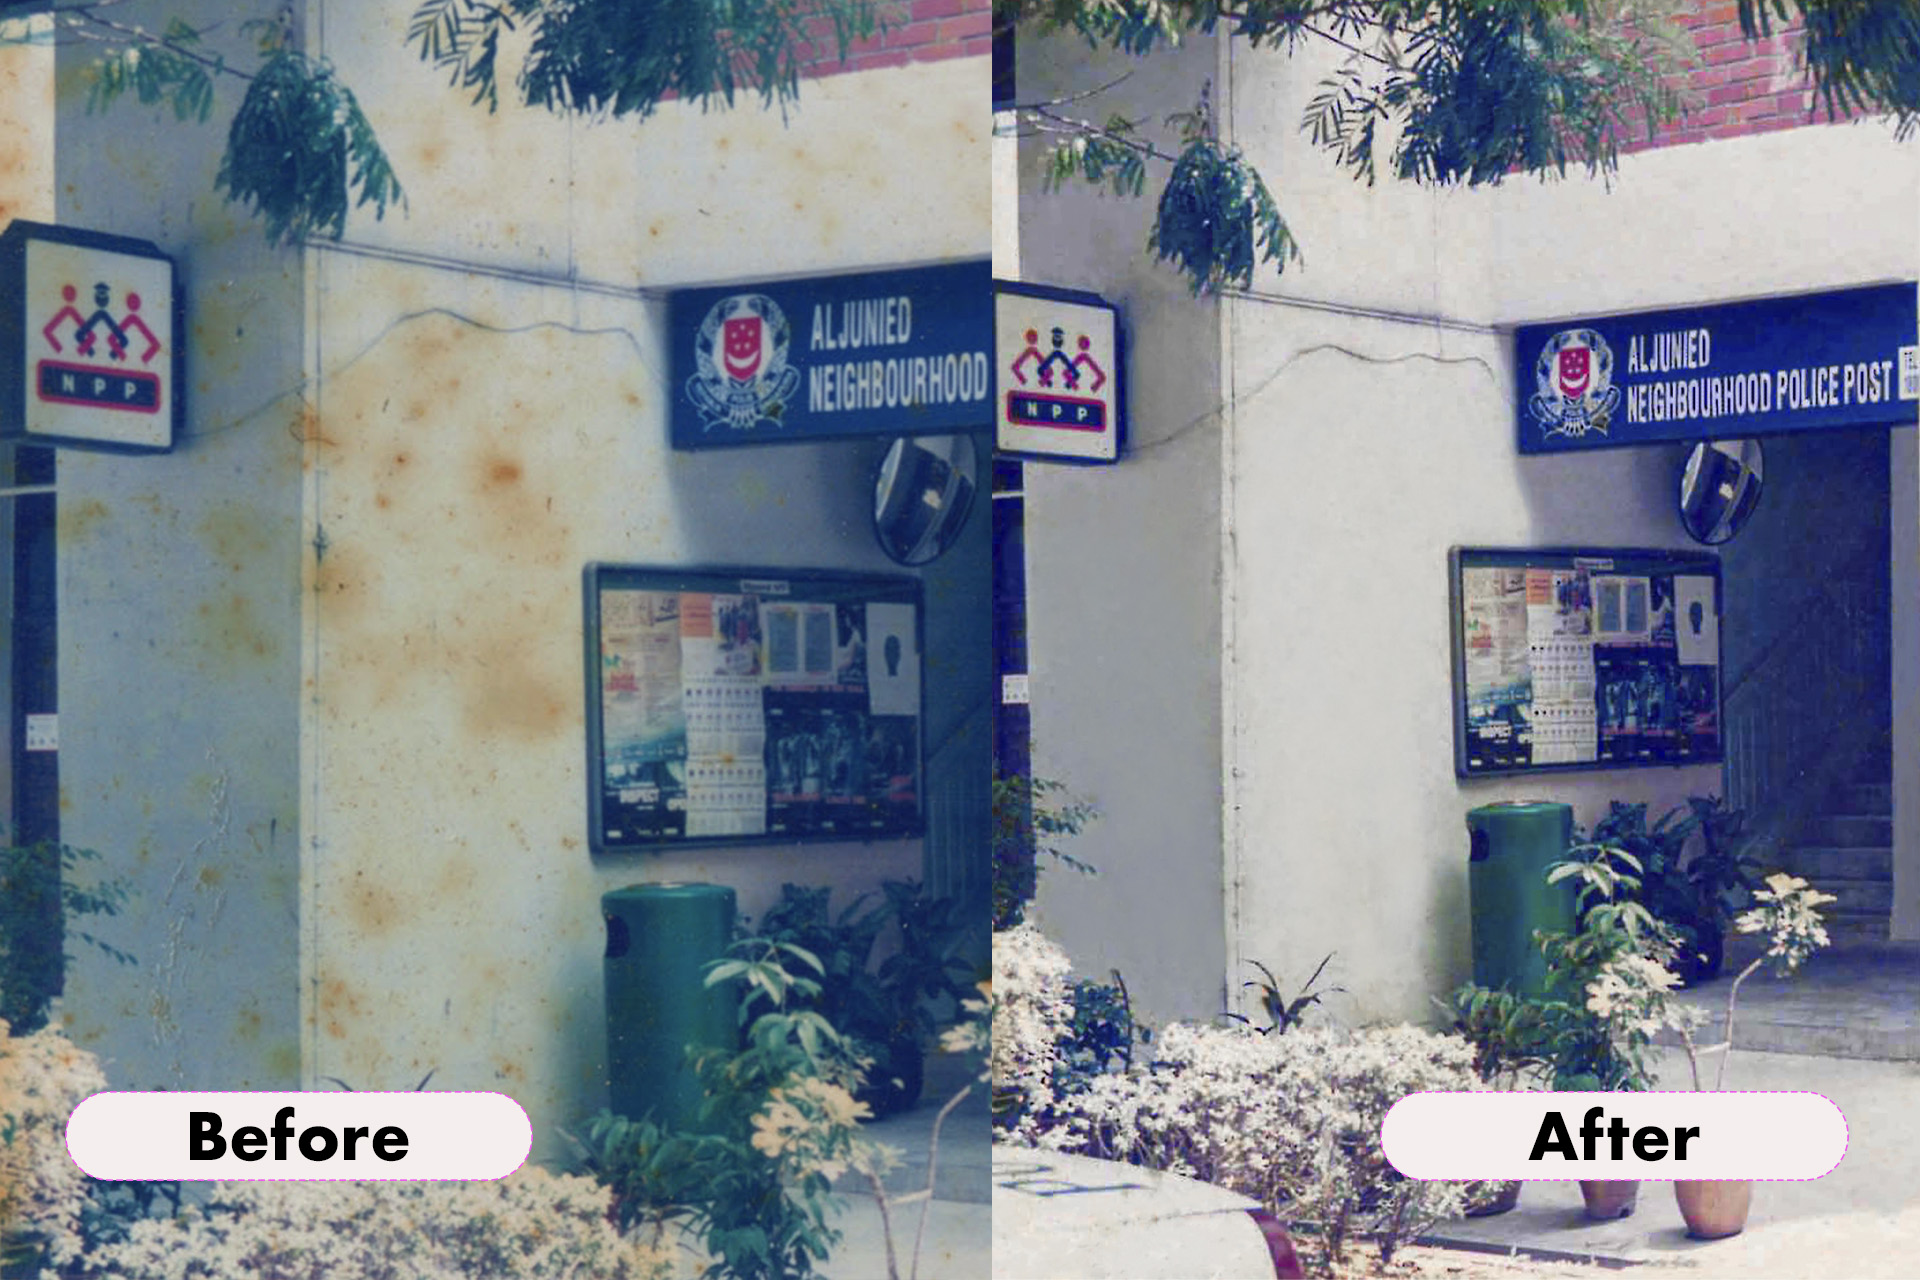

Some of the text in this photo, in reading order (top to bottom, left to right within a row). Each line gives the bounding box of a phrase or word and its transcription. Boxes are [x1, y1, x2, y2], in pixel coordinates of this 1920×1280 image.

[811, 296, 912, 351] ALJUNIED
[1628, 328, 1711, 374] ALJUNIED
[809, 352, 988, 413] NEIGHBOURHOOD
[1627, 361, 1894, 424] NEIGHBOURHOOD POLICE POST
